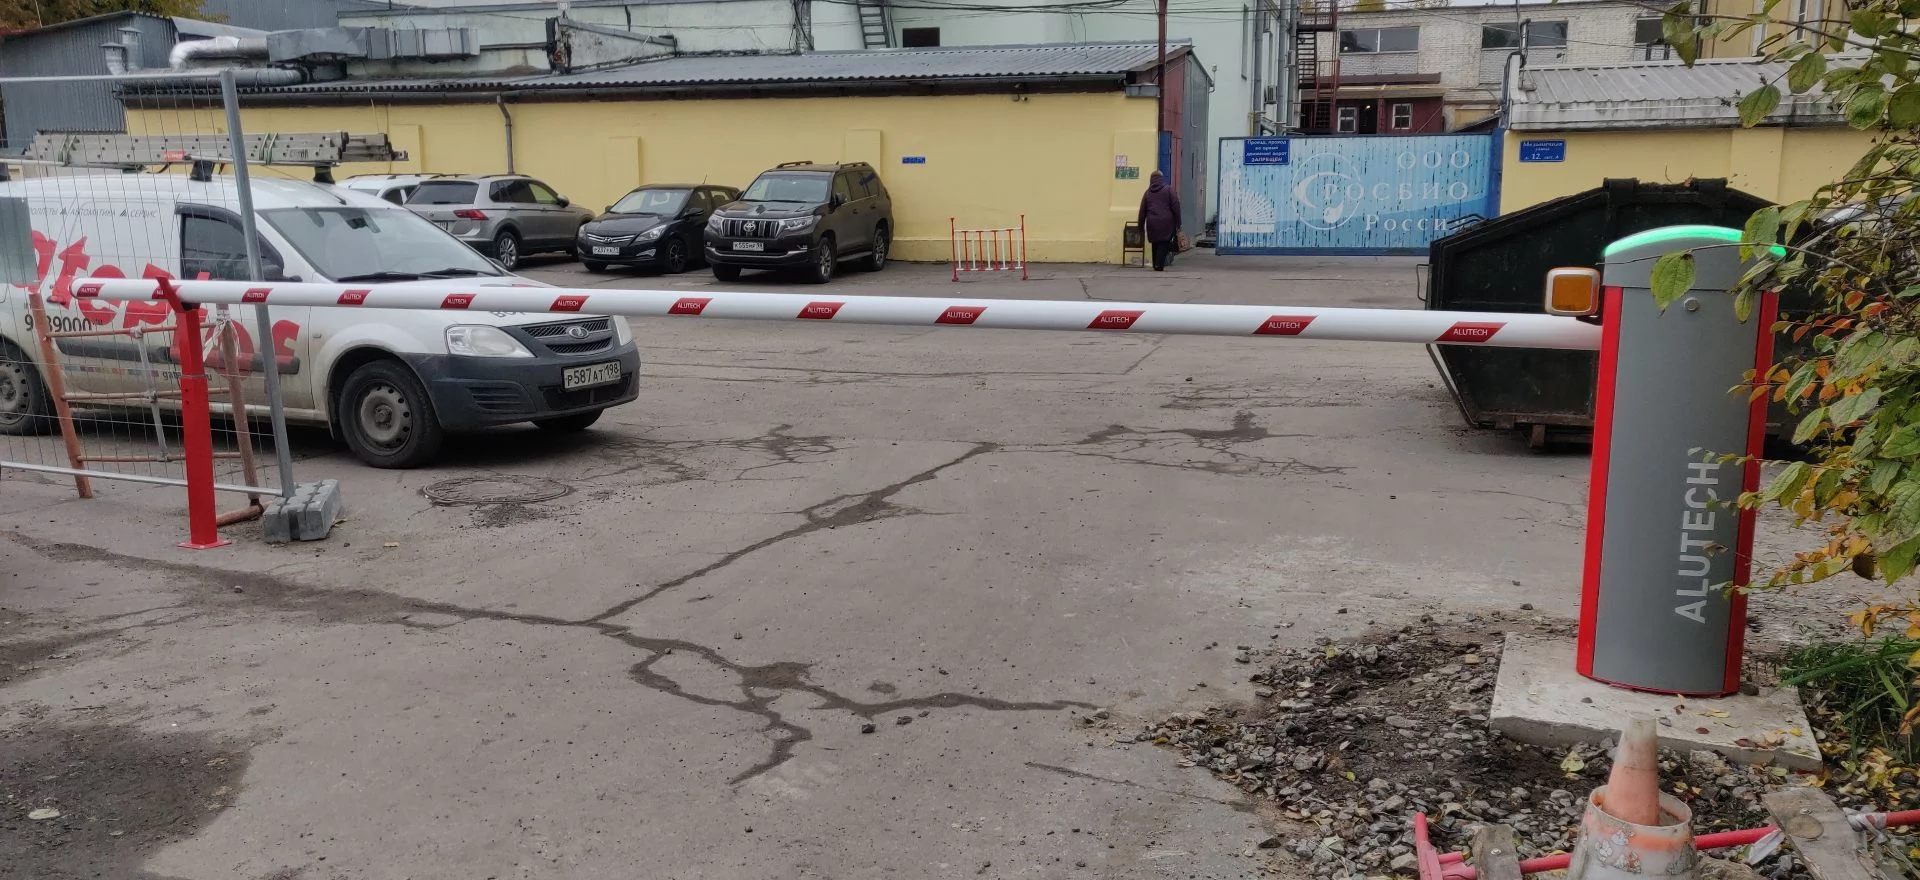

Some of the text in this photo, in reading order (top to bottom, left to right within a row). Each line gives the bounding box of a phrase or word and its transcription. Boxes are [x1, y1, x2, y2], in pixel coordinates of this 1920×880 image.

[1322, 181, 1469, 201] РОСБИО
[807, 306, 833, 314] ALUTECH
[946, 311, 974, 319] ALUTECH
[1268, 321, 1301, 329] ALUTECH
[1453, 328, 1489, 337] ALUTECH
[1674, 462, 1720, 625] ALUTECH
